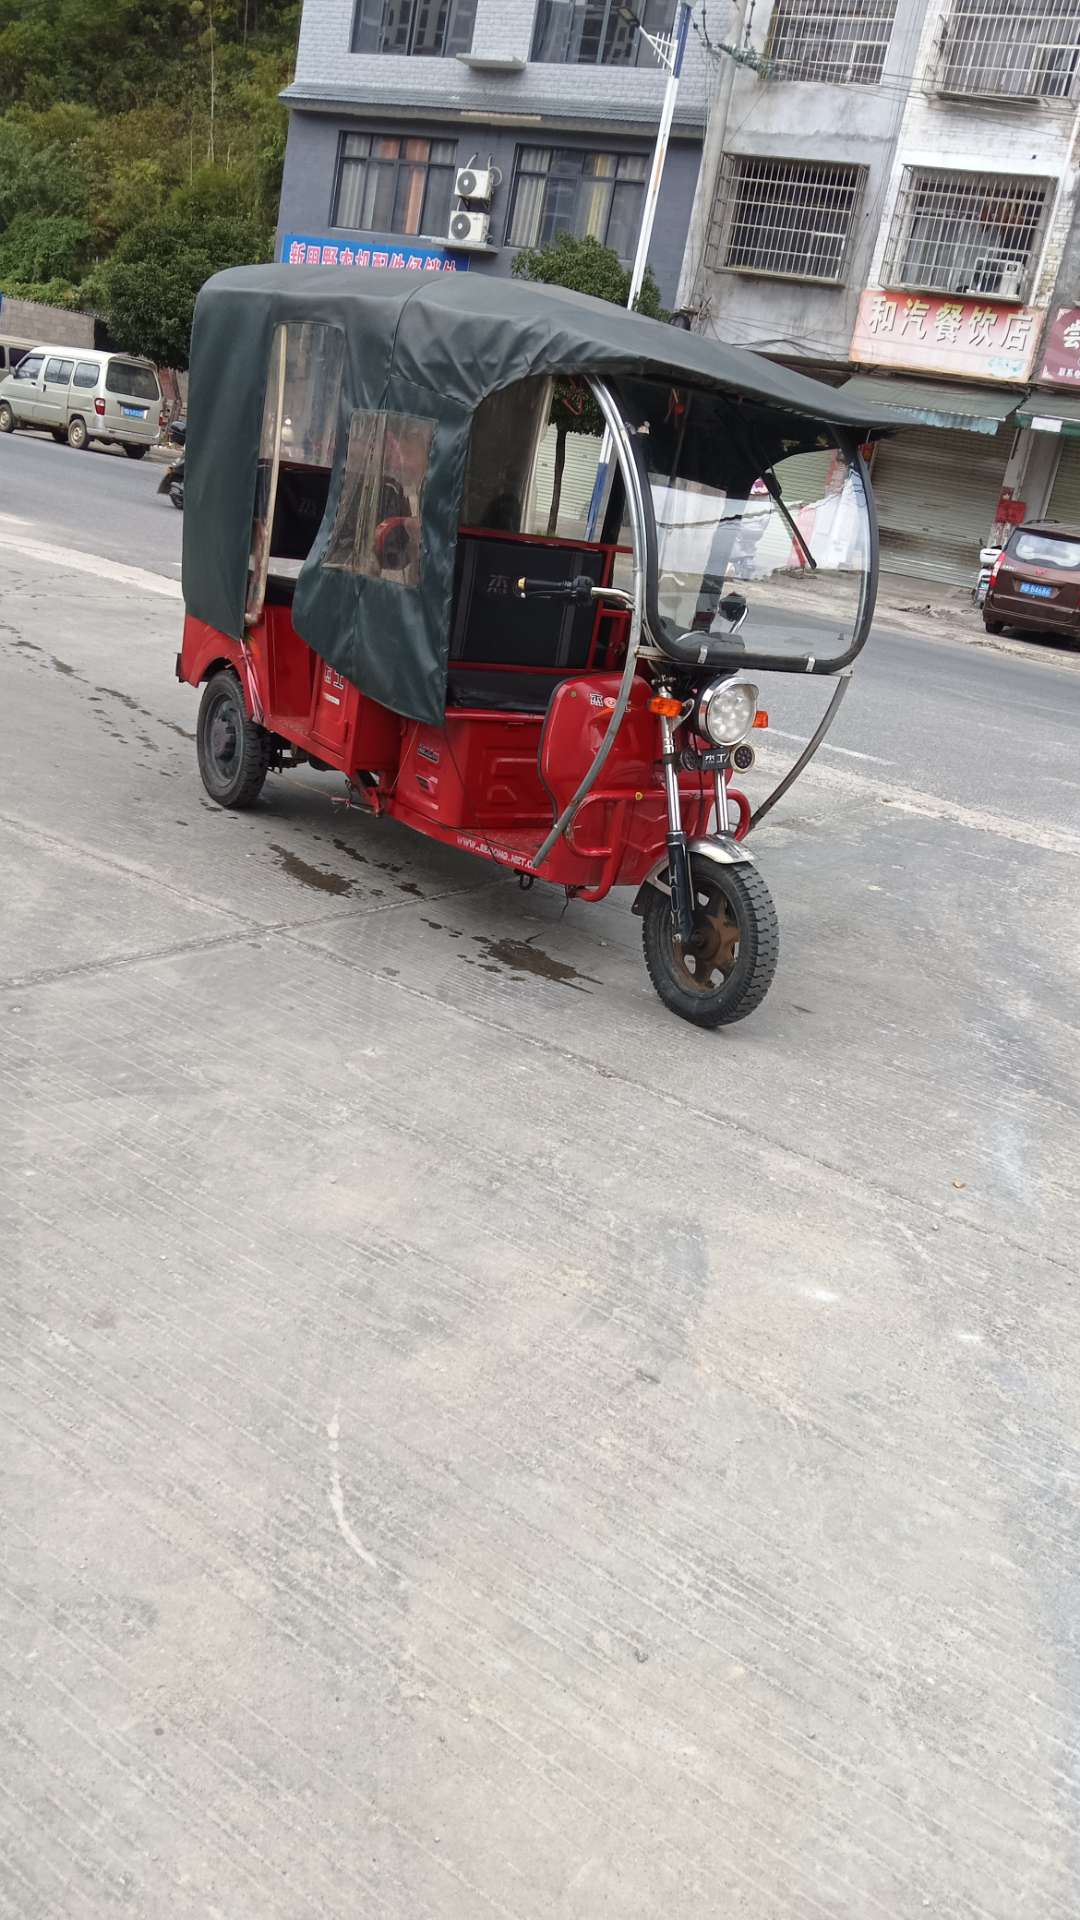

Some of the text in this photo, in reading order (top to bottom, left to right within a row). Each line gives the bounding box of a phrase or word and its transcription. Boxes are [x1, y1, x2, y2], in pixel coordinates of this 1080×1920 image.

[868, 295, 1033, 351] 和汽餐饮店
